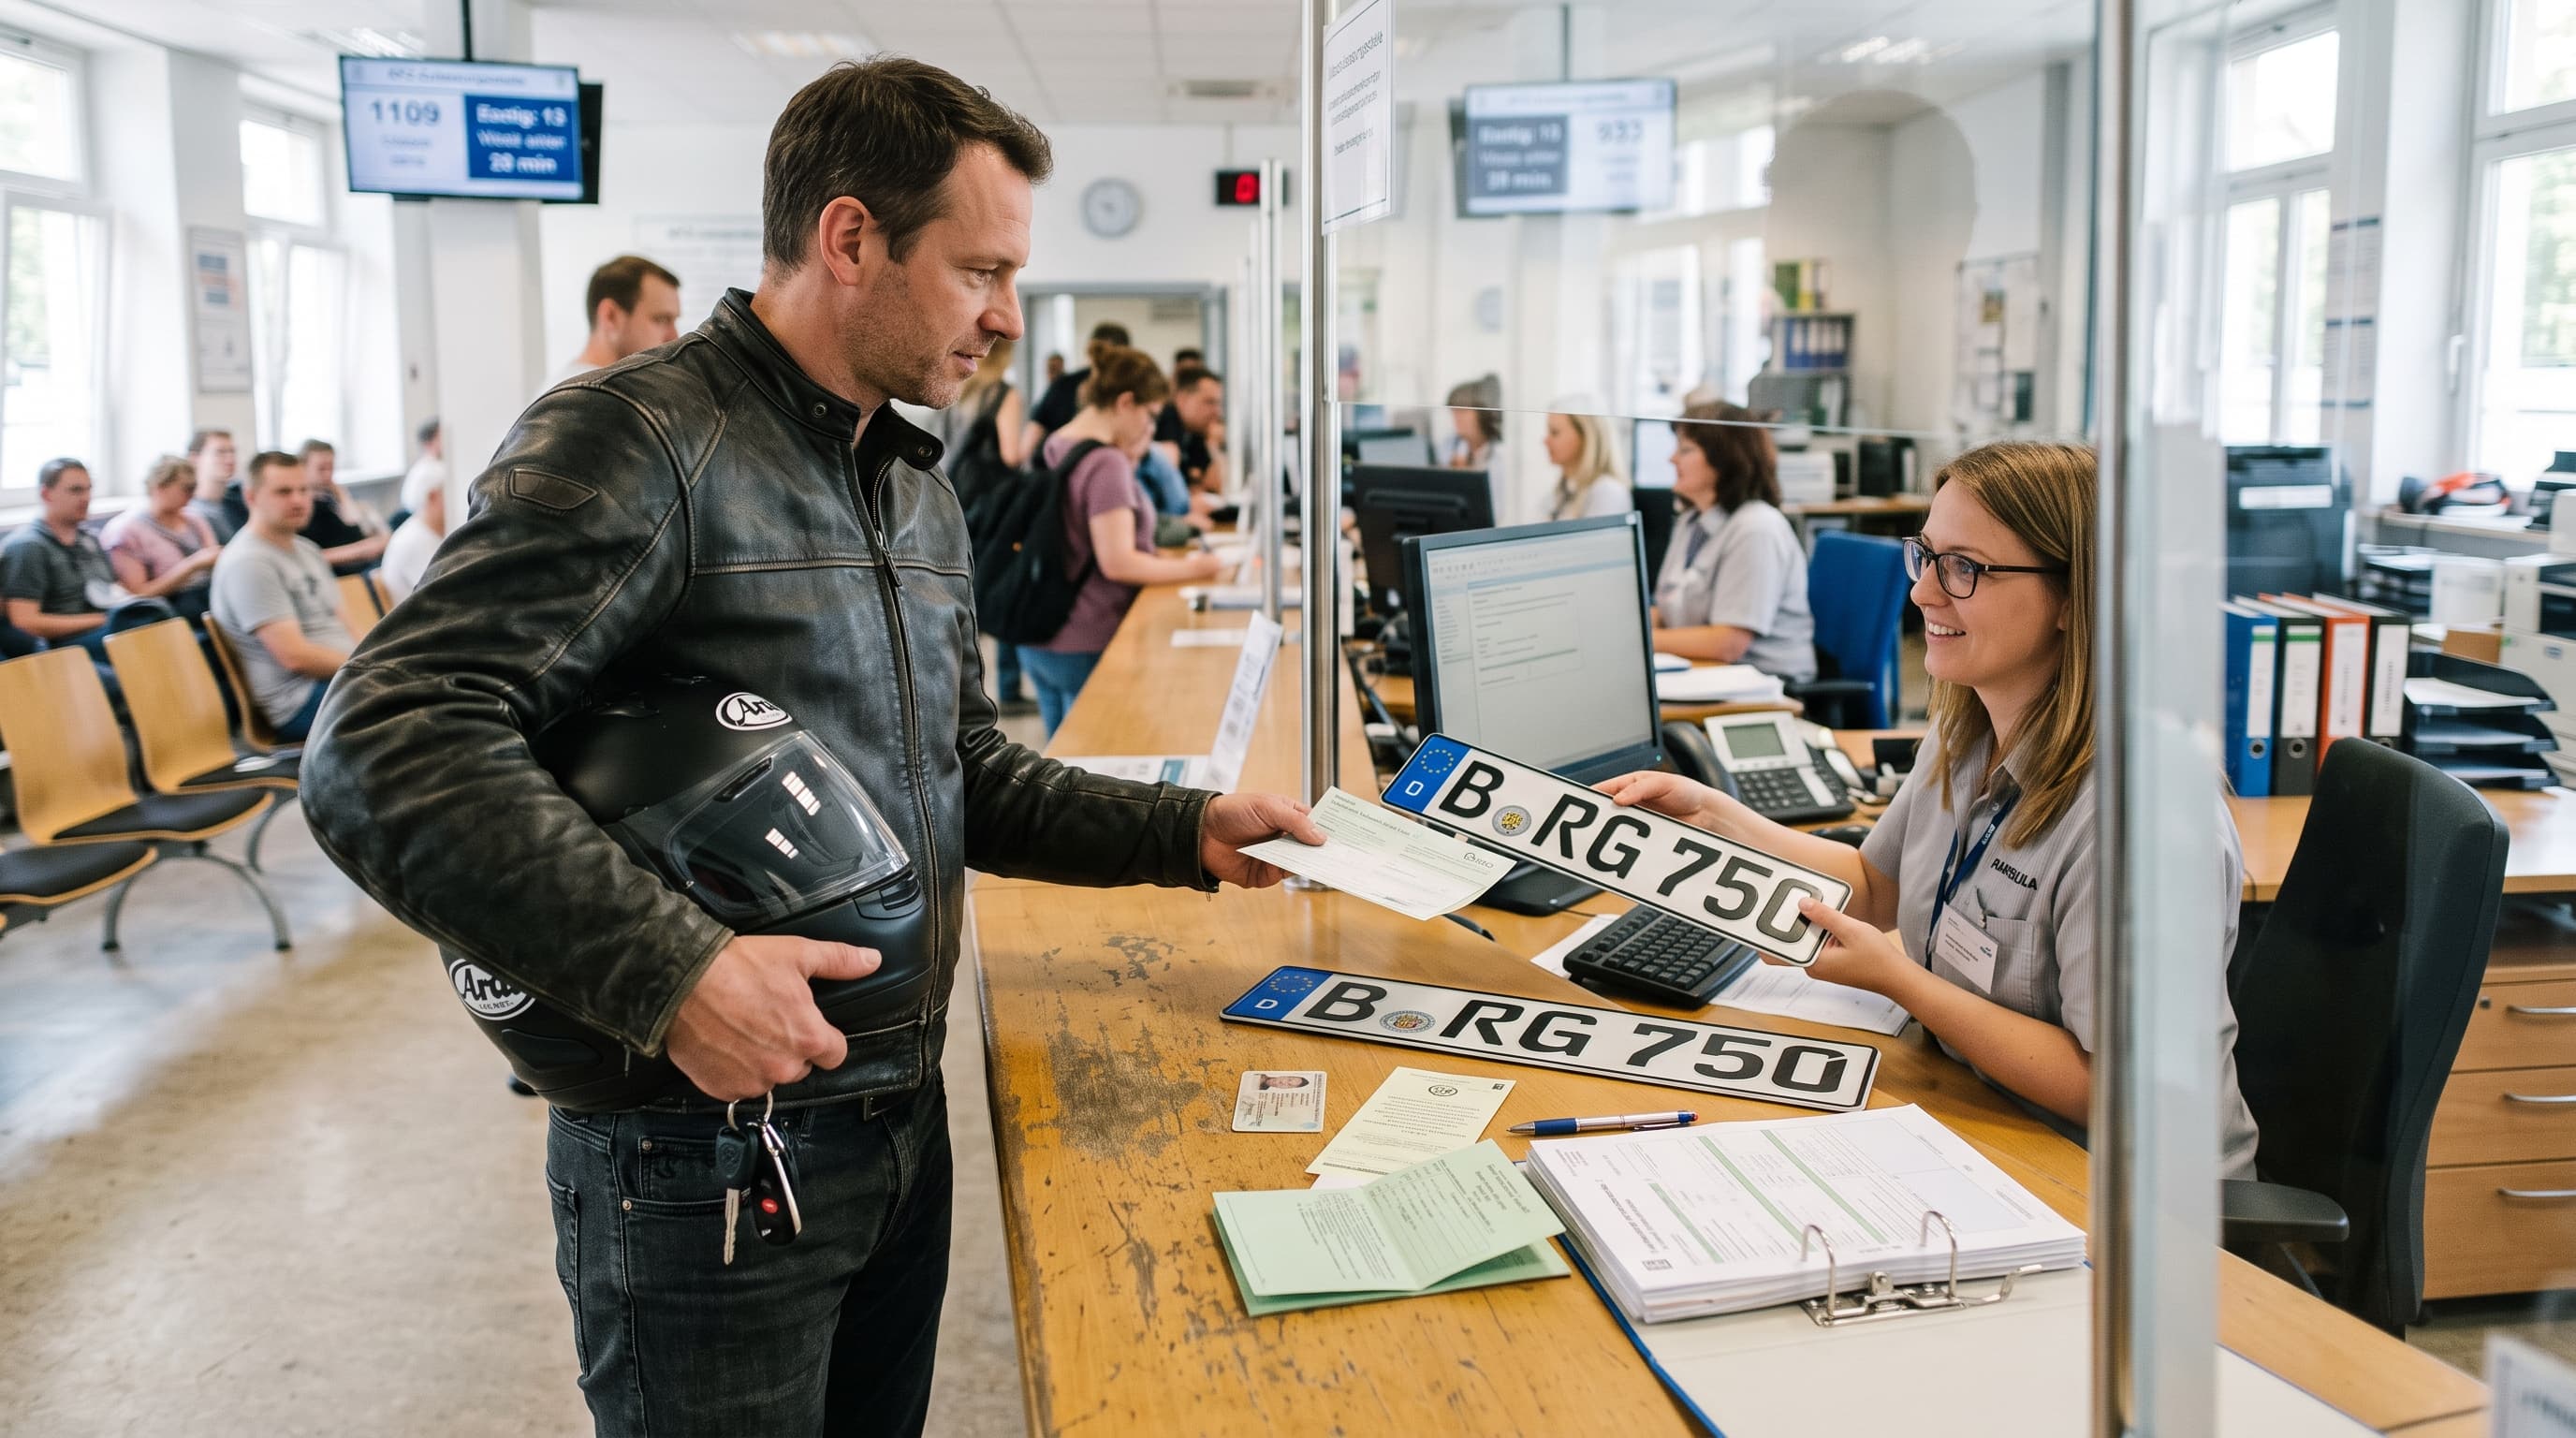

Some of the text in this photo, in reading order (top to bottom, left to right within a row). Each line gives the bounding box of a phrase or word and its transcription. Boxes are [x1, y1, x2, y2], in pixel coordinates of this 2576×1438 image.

[371, 100, 441, 126] 1109
[517, 154, 558, 174] min
[1405, 780, 1424, 797] D
[1439, 760, 1504, 818] B
[1530, 793, 1650, 879] RG
[1656, 837, 1823, 944] 750
[1254, 1000, 1280, 1009] D
[1304, 981, 1388, 1023] B
[1439, 999, 1597, 1056] RG
[1627, 1030, 1847, 1093] 750
